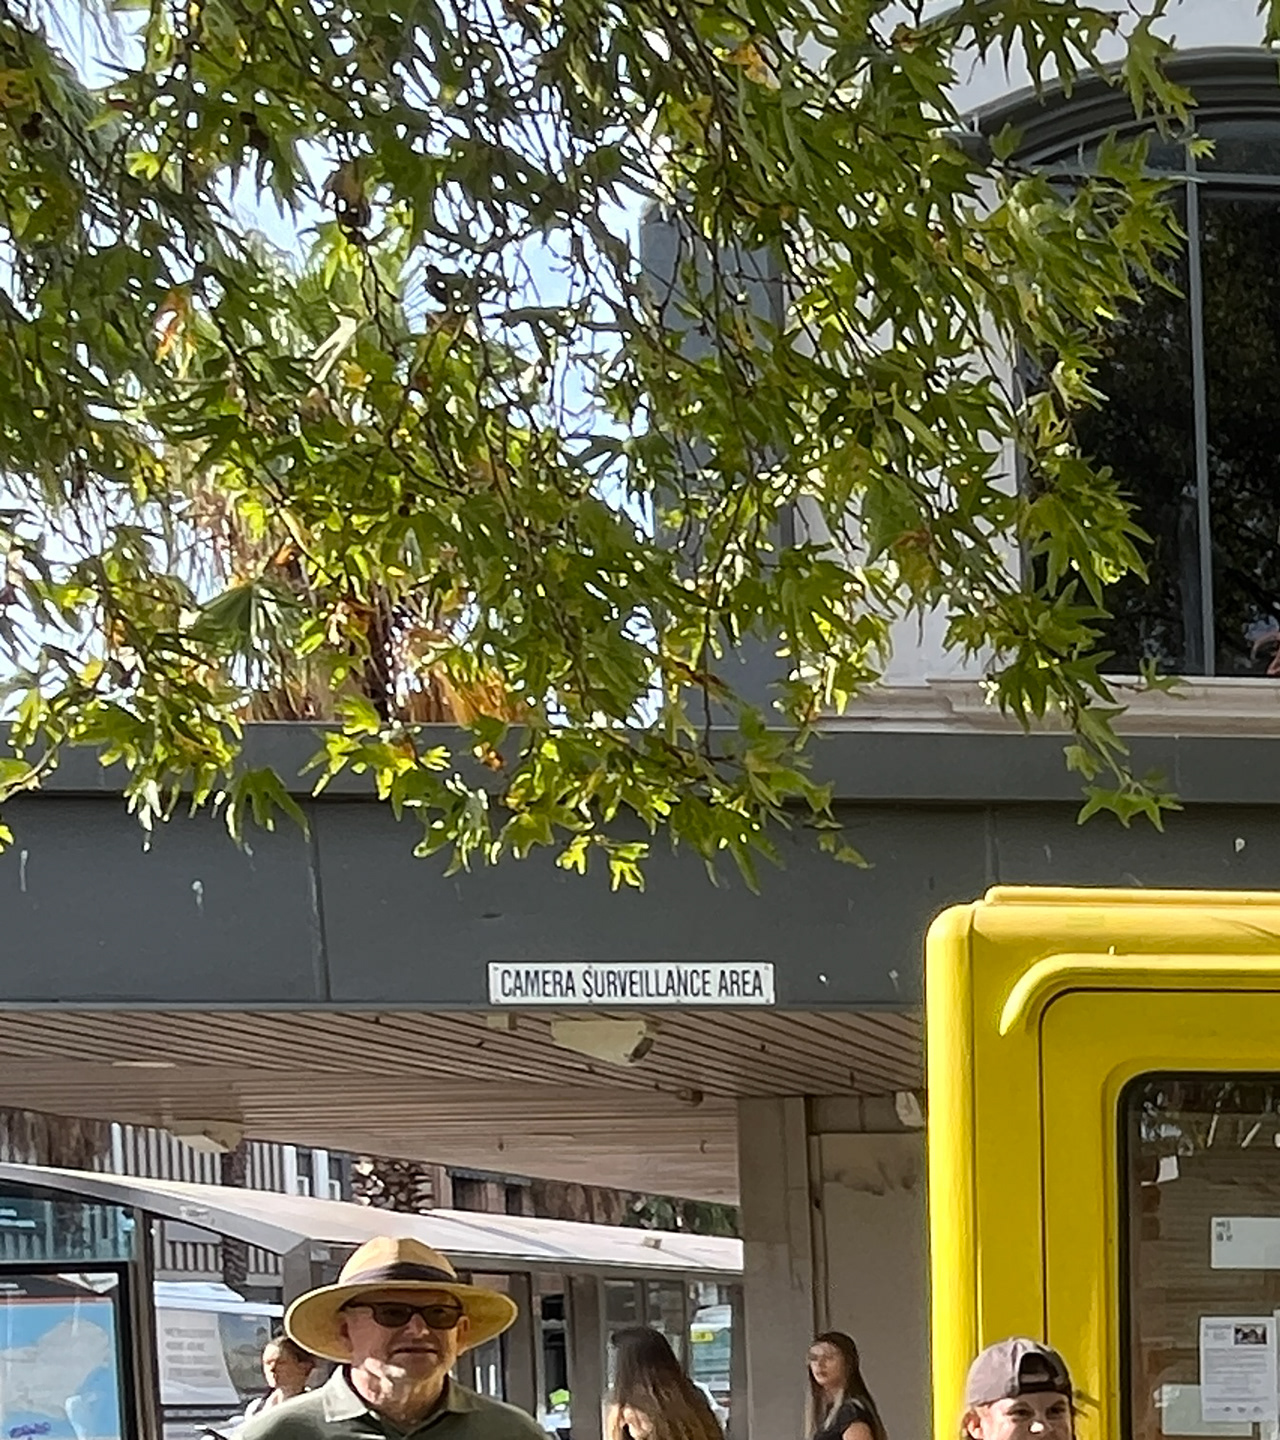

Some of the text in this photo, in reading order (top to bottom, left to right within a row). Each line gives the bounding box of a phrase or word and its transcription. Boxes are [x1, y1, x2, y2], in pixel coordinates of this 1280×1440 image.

[501, 969, 764, 997] CAMERA SURVEILLANCE AREA
